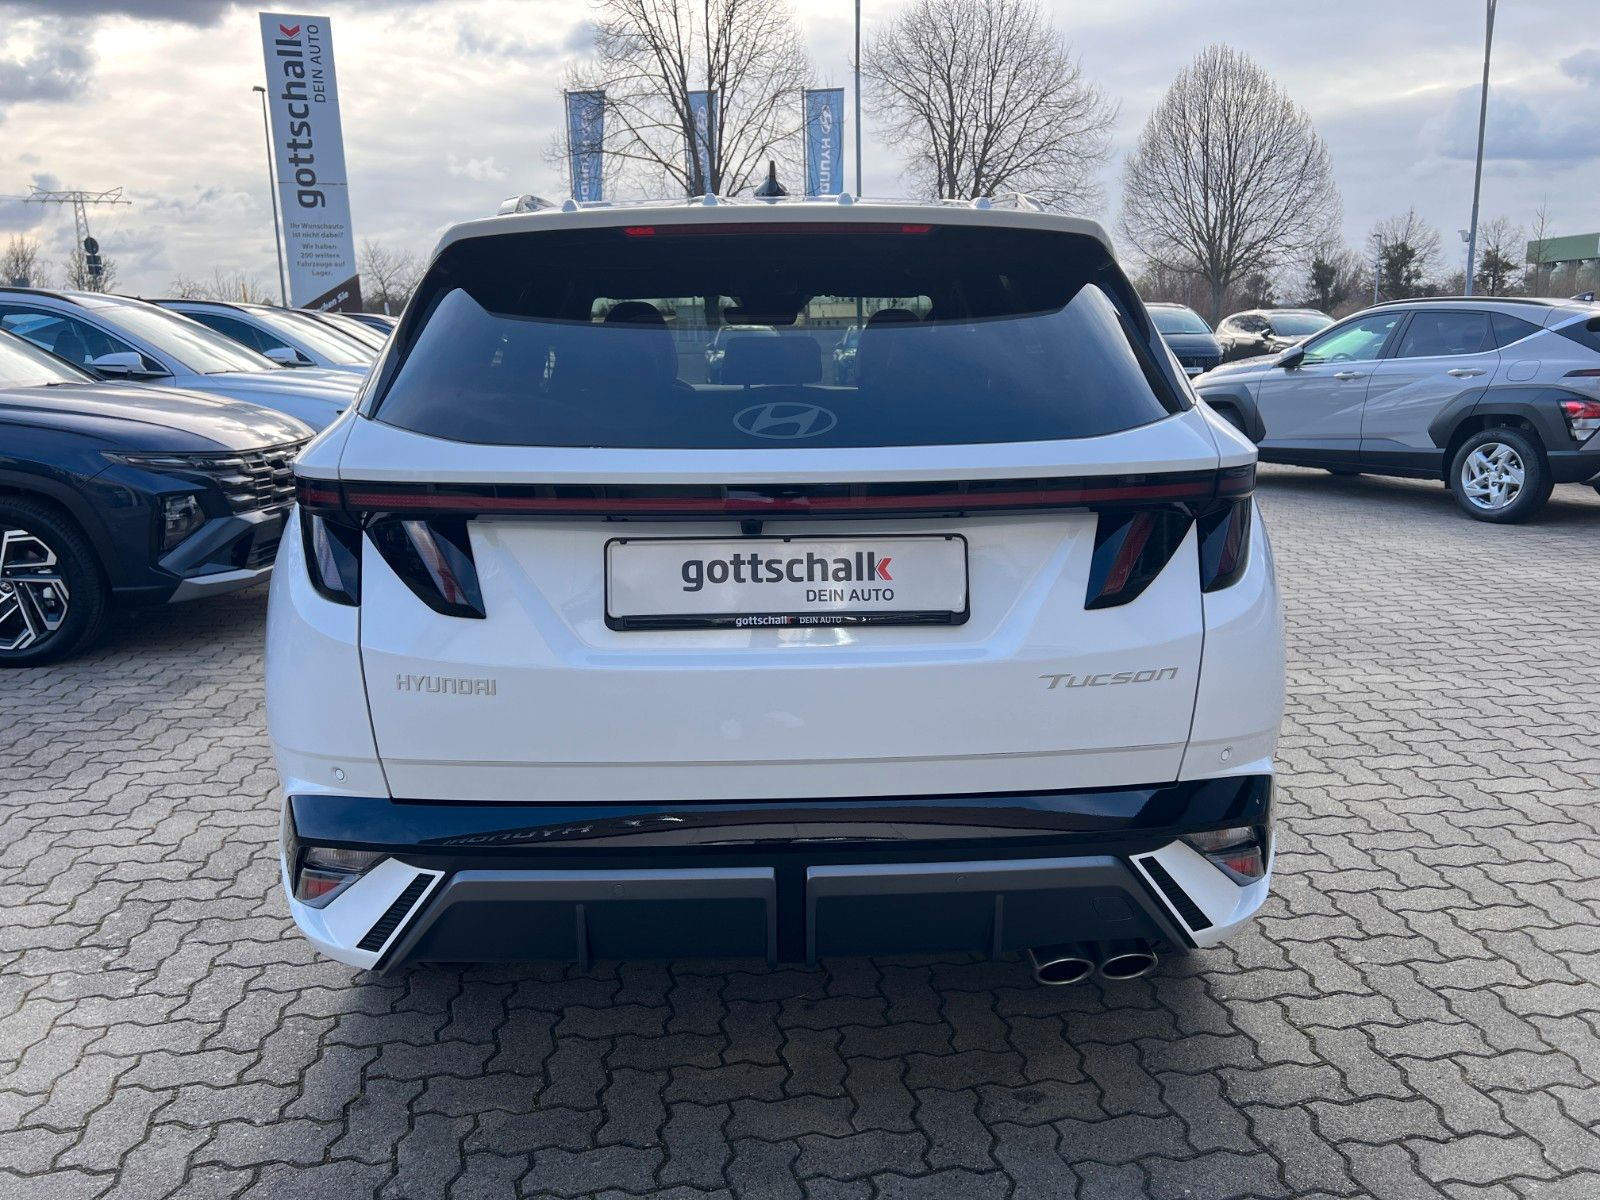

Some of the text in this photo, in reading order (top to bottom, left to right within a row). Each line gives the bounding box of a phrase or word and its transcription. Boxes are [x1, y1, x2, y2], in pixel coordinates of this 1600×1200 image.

[306, 24, 326, 103] DEIN AUTO
[275, 23, 326, 209] gottschalk
[819, 137, 832, 193] HYUND
[301, 222, 344, 230] Wunschauto
[296, 260, 333, 268] Fahrzeuge
[681, 551, 893, 592] gottschalk
[806, 587, 895, 603] DEIN AUTO
[799, 616, 842, 625] DEIN AUTO
[395, 673, 497, 696] HYUNDAI
